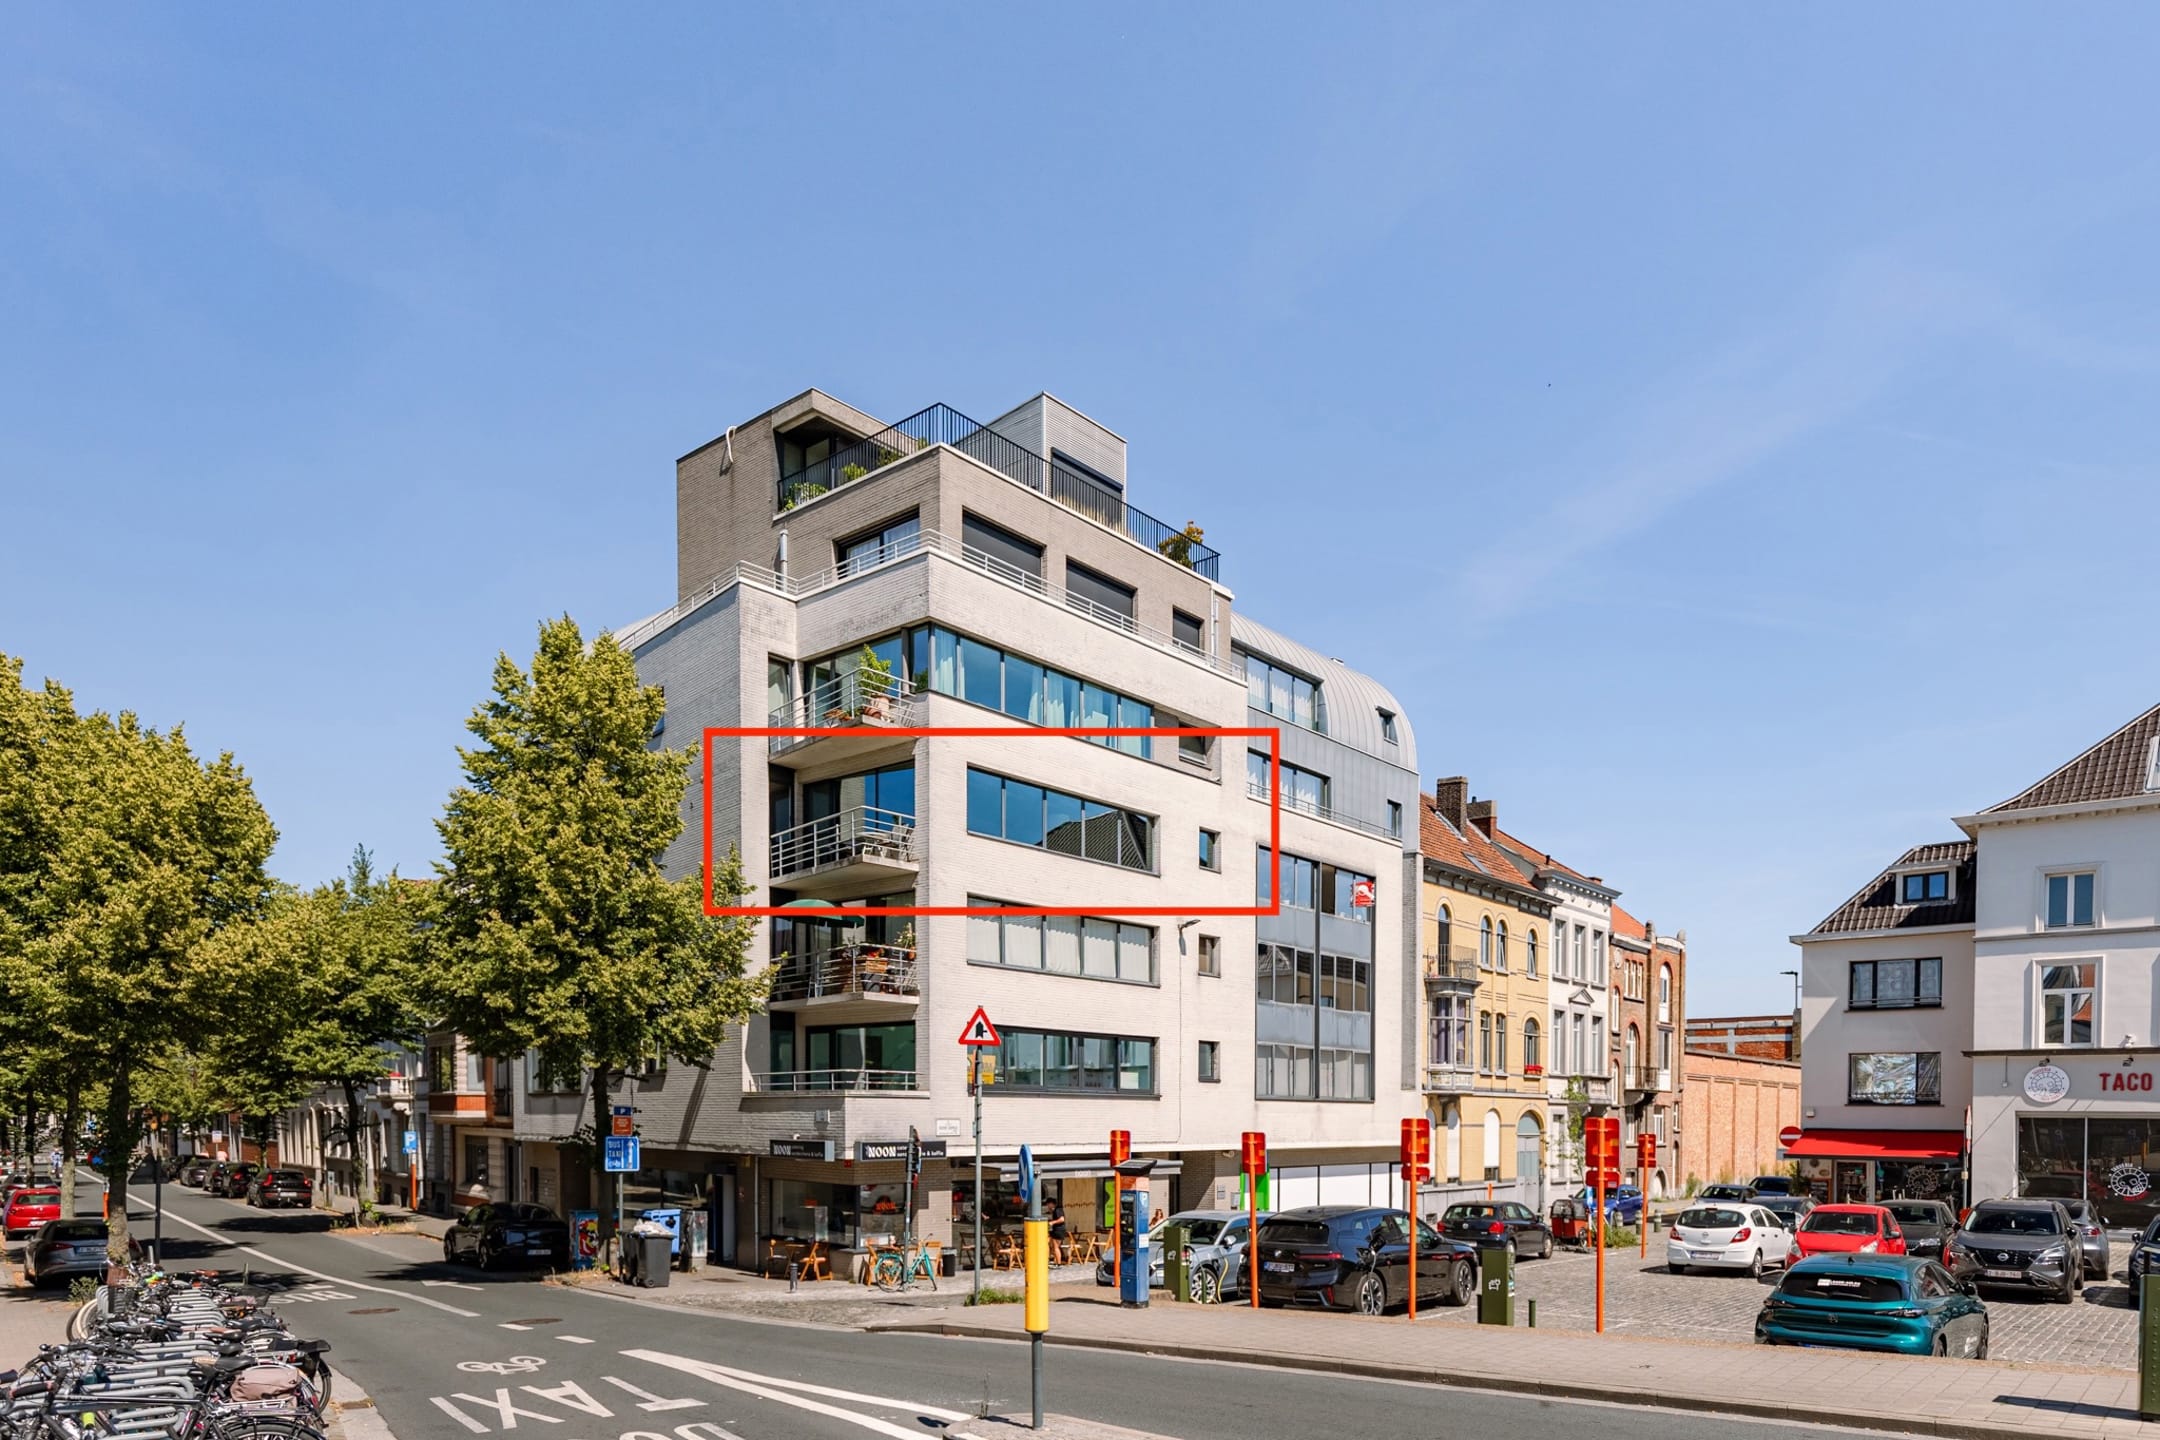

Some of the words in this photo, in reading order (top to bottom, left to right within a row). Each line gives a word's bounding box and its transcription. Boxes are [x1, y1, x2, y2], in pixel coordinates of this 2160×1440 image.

[2099, 1073, 2153, 1091] TACO
[405, 1132, 416, 1147] P
[608, 1141, 621, 1149] BUS
[608, 1150, 622, 1158] TAXI
[868, 1146, 896, 1158] NOON
[429, 1376, 709, 1434] TAXI
